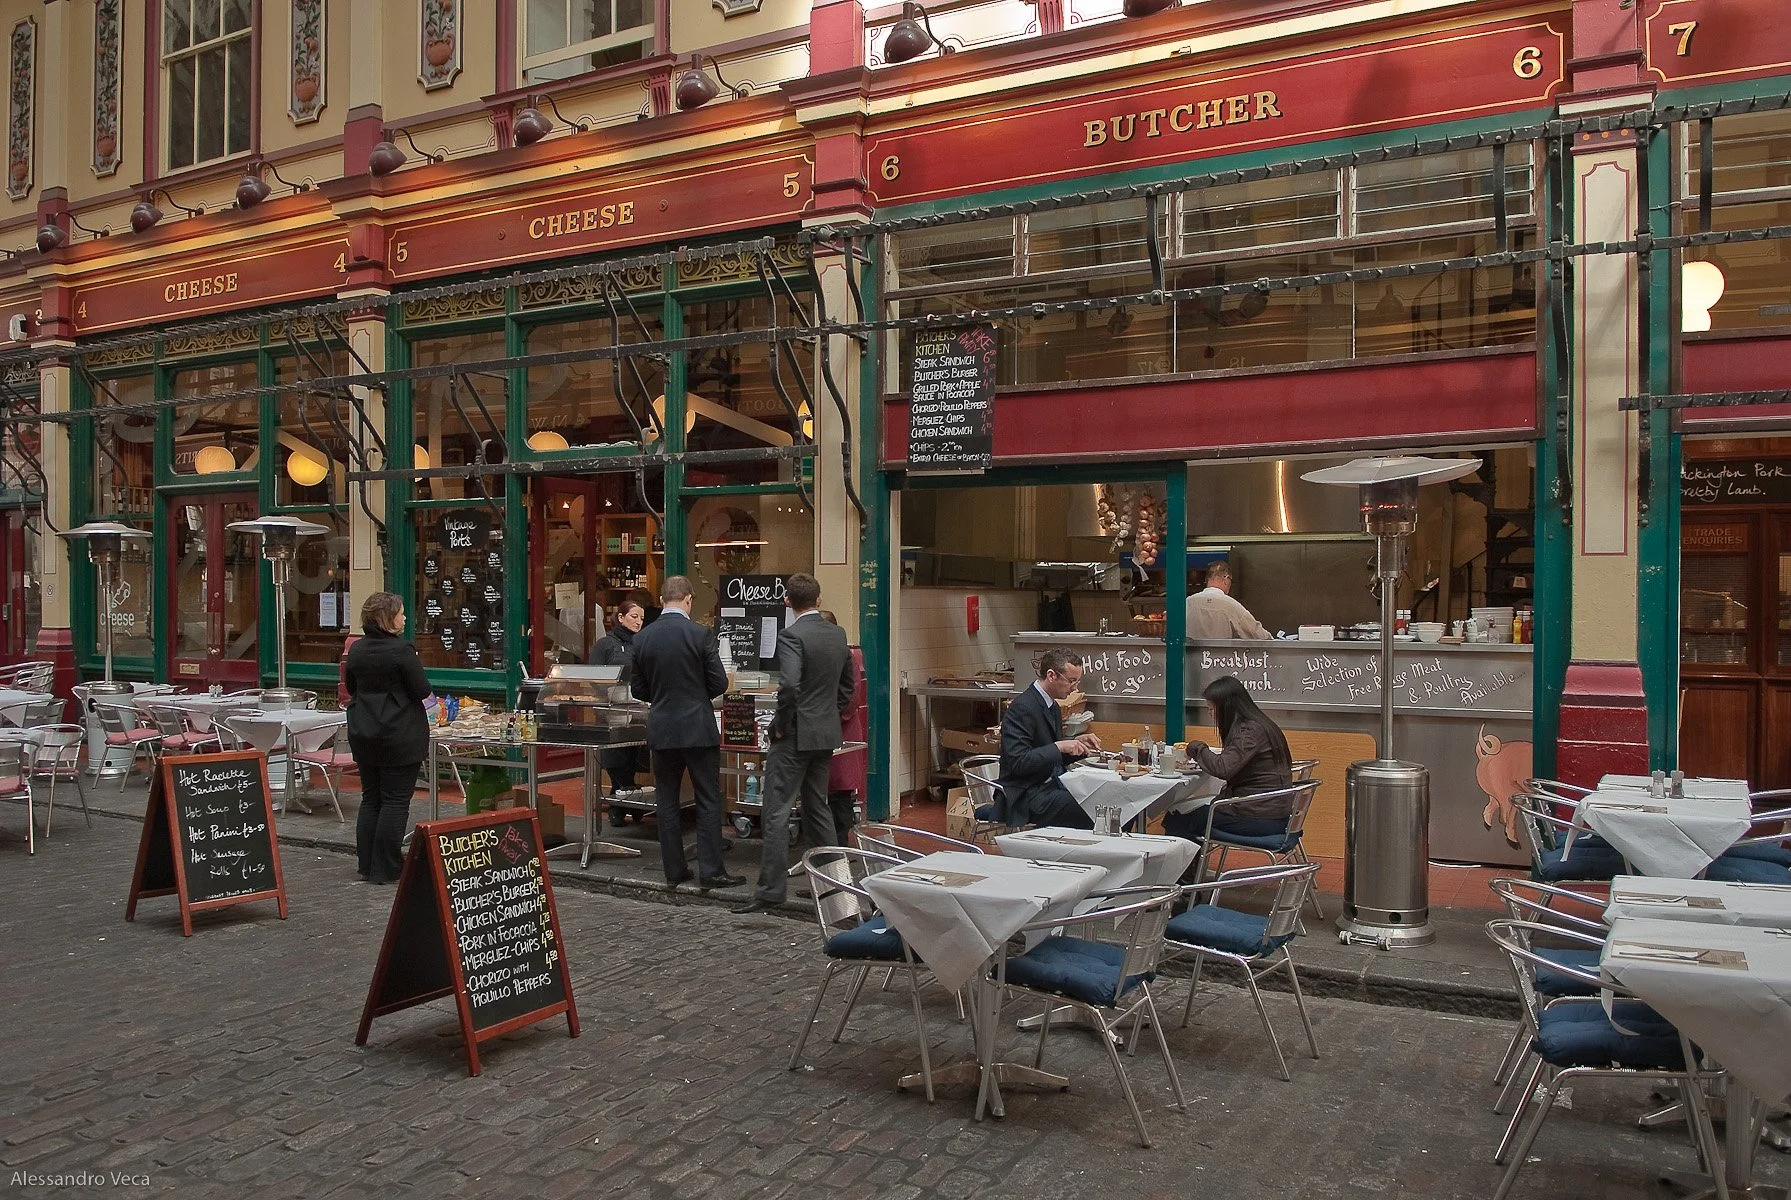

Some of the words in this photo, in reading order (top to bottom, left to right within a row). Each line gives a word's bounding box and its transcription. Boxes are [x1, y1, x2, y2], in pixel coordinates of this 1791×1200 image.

[1668, 20, 1699, 57] 7
[1512, 46, 1543, 79] 6
[1083, 90, 1283, 148] BUTCHER
[880, 155, 900, 181] 6
[782, 172, 801, 198] 5
[528, 200, 636, 240] CHEESE
[333, 252, 347, 273] 4
[396, 241, 410, 264] 5
[163, 272, 239, 303] CHEESE
[77, 300, 87, 319] 4
[915, 344, 950, 356] KITCHEN
[914, 358, 938, 370] STEAK
[939, 355, 976, 367] SANDWICH
[914, 370, 950, 382] BUTCHER'S
[951, 368, 978, 379] BURGER
[912, 383, 940, 394] GRILLED
[938, 391, 945, 400] IN
[939, 426, 973, 437] SANDWICH
[912, 441, 936, 452] CHIPS
[933, 452, 957, 463] CHEESE
[444, 518, 477, 535] Vintage
[1694, 528, 1732, 537] TRADE
[1683, 536, 1743, 546] ENQUIRIES
[727, 578, 775, 601] Cheese
[100, 611, 134, 626] ceese
[1081, 651, 1110, 675] Hot
[1116, 649, 1152, 672] Food
[1306, 654, 1339, 673] Wide
[1101, 675, 1117, 693] to
[1301, 666, 1362, 694] Selection
[1365, 655, 1377, 675] of
[1347, 683, 1372, 702] Free
[1410, 657, 1443, 679] Meat
[1408, 687, 1422, 705] &
[1423, 673, 1474, 699] Poultry
[179, 769, 201, 786] Hot
[188, 783, 237, 796] Sandwich
[185, 806, 202, 819] Hot
[188, 825, 206, 843] Hot
[210, 824, 241, 840] Panini
[439, 829, 499, 856] BUTCHER'S
[191, 848, 207, 863] Hot
[444, 850, 492, 876] KITCHEN
[450, 876, 483, 896] STEAK
[484, 865, 529, 885] SANDWICH
[454, 890, 502, 914] BUTCHER'S
[502, 882, 536, 901] BURGER
[456, 911, 498, 934] CHICKEN
[497, 900, 537, 921] SANDWICH
[460, 935, 487, 953] PORK
[487, 931, 497, 946] IN
[498, 922, 538, 941] FOCACCIA
[468, 968, 511, 992] CHORIZO
[471, 986, 511, 1008] PIQUILLO
[512, 972, 552, 996] PEPPERS
